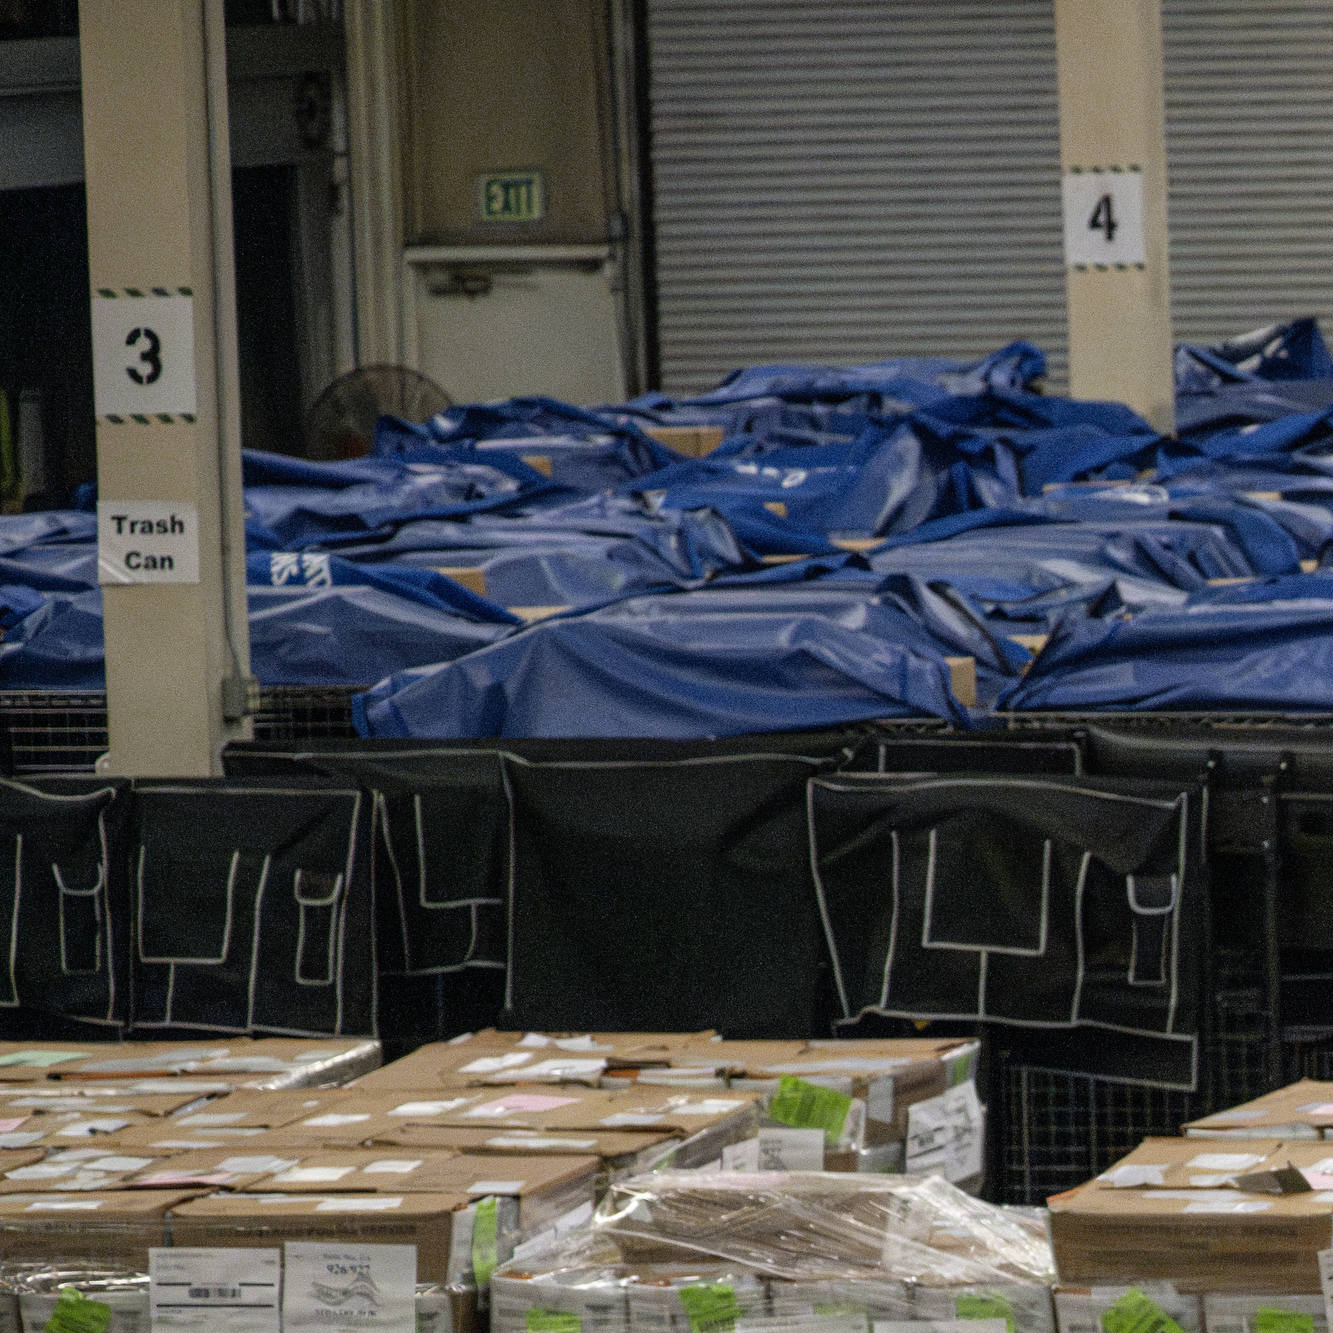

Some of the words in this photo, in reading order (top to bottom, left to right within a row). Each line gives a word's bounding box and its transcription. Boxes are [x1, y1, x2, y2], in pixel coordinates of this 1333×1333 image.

[1087, 195, 1118, 242] 4
[126, 328, 161, 385] 3
[111, 514, 184, 534] Trash
[124, 551, 174, 570] Can
